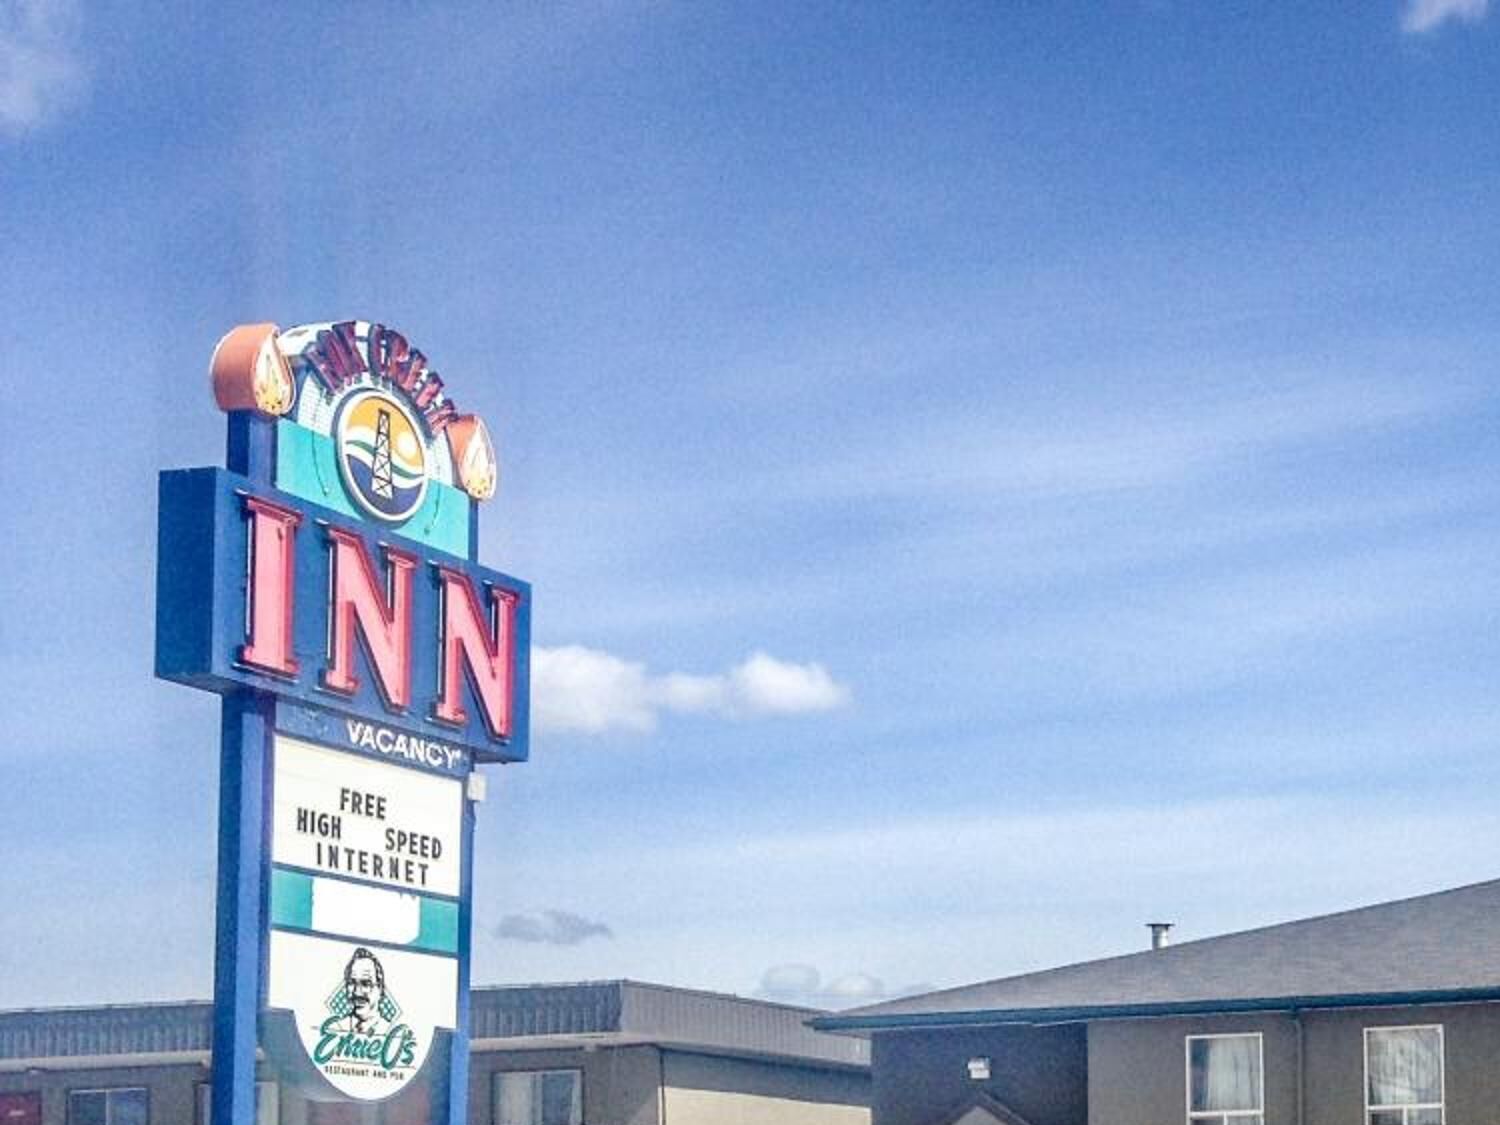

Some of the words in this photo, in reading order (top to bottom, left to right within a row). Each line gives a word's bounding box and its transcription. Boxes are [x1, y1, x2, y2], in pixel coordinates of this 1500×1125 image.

[238, 495, 520, 742] INN
[346, 720, 462, 769] VACANCY
[339, 787, 387, 820] FREE
[296, 807, 342, 840] HIGH
[385, 828, 442, 860] SPEED
[316, 842, 429, 886] INTERNET
